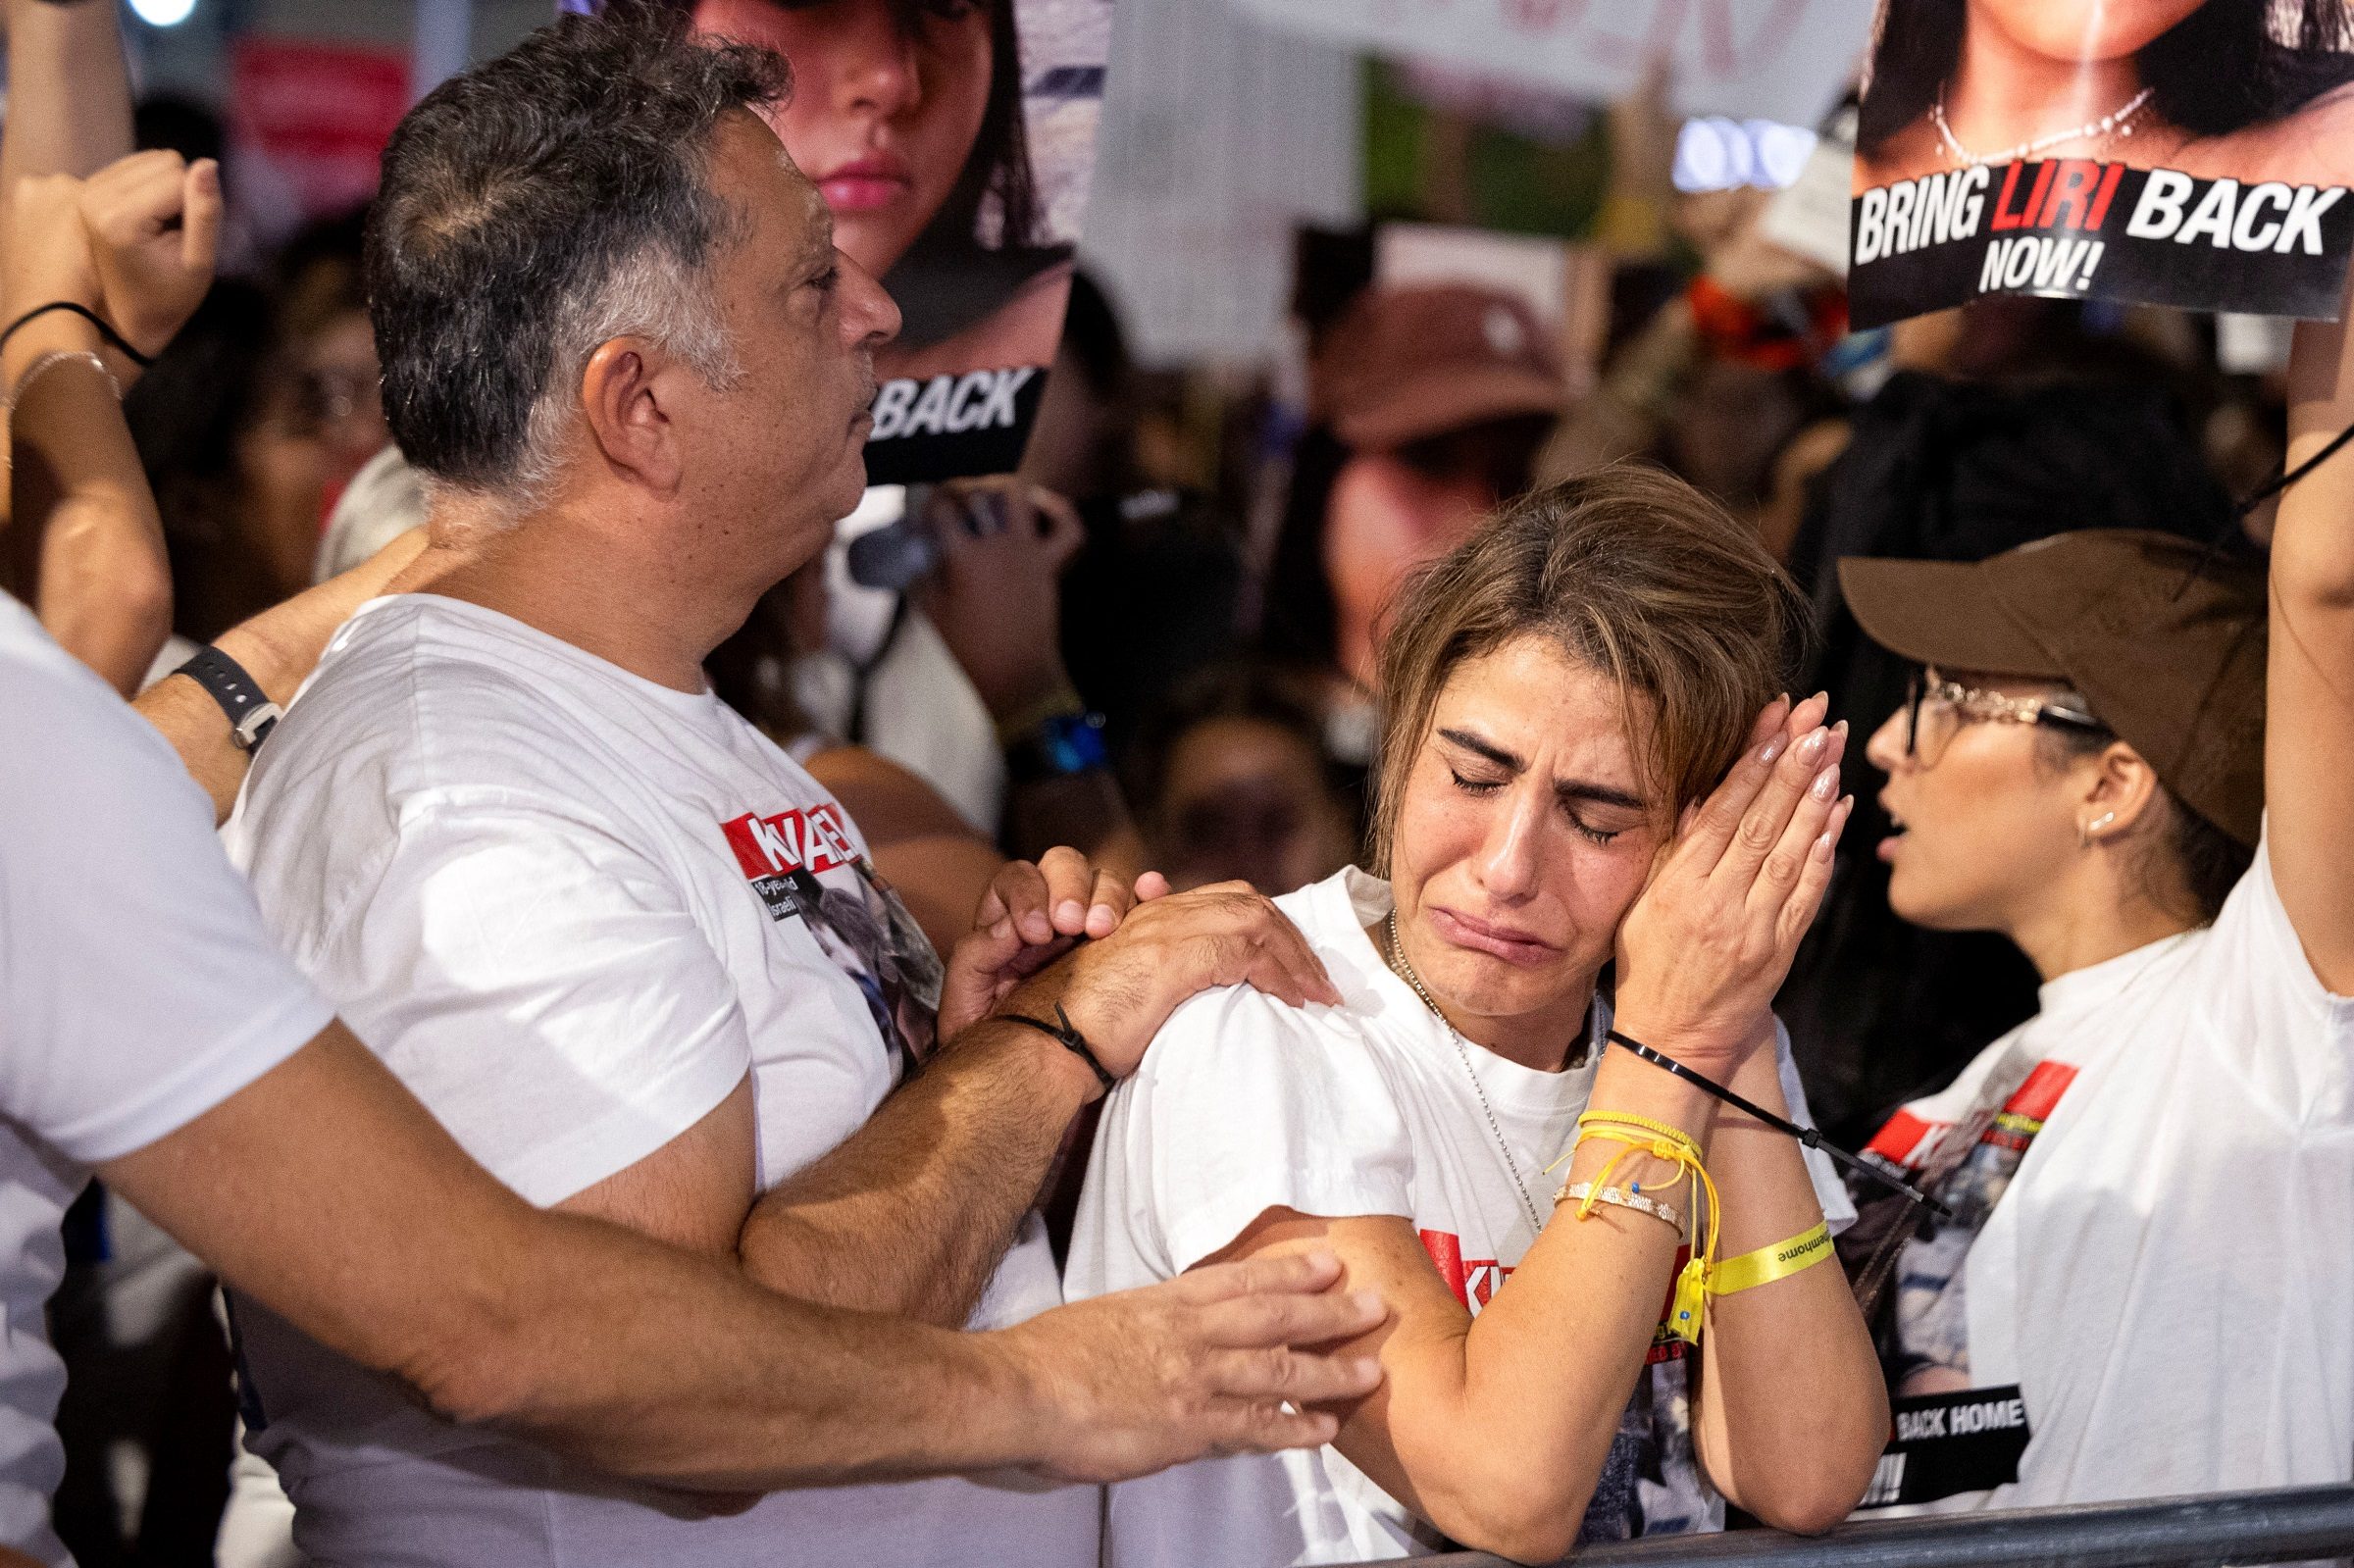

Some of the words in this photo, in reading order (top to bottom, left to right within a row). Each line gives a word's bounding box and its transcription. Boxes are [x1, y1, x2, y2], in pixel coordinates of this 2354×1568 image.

[1856, 165, 1990, 266] BRING
[1991, 159, 2124, 231] LIRI
[2125, 168, 2347, 255] BACK
[1978, 236, 2106, 292] NOW!
[869, 365, 1037, 441] BACK
[767, 895, 797, 917] Israeli
[1896, 1406, 1947, 1442] BACK
[1949, 1397, 2026, 1437] HOME
